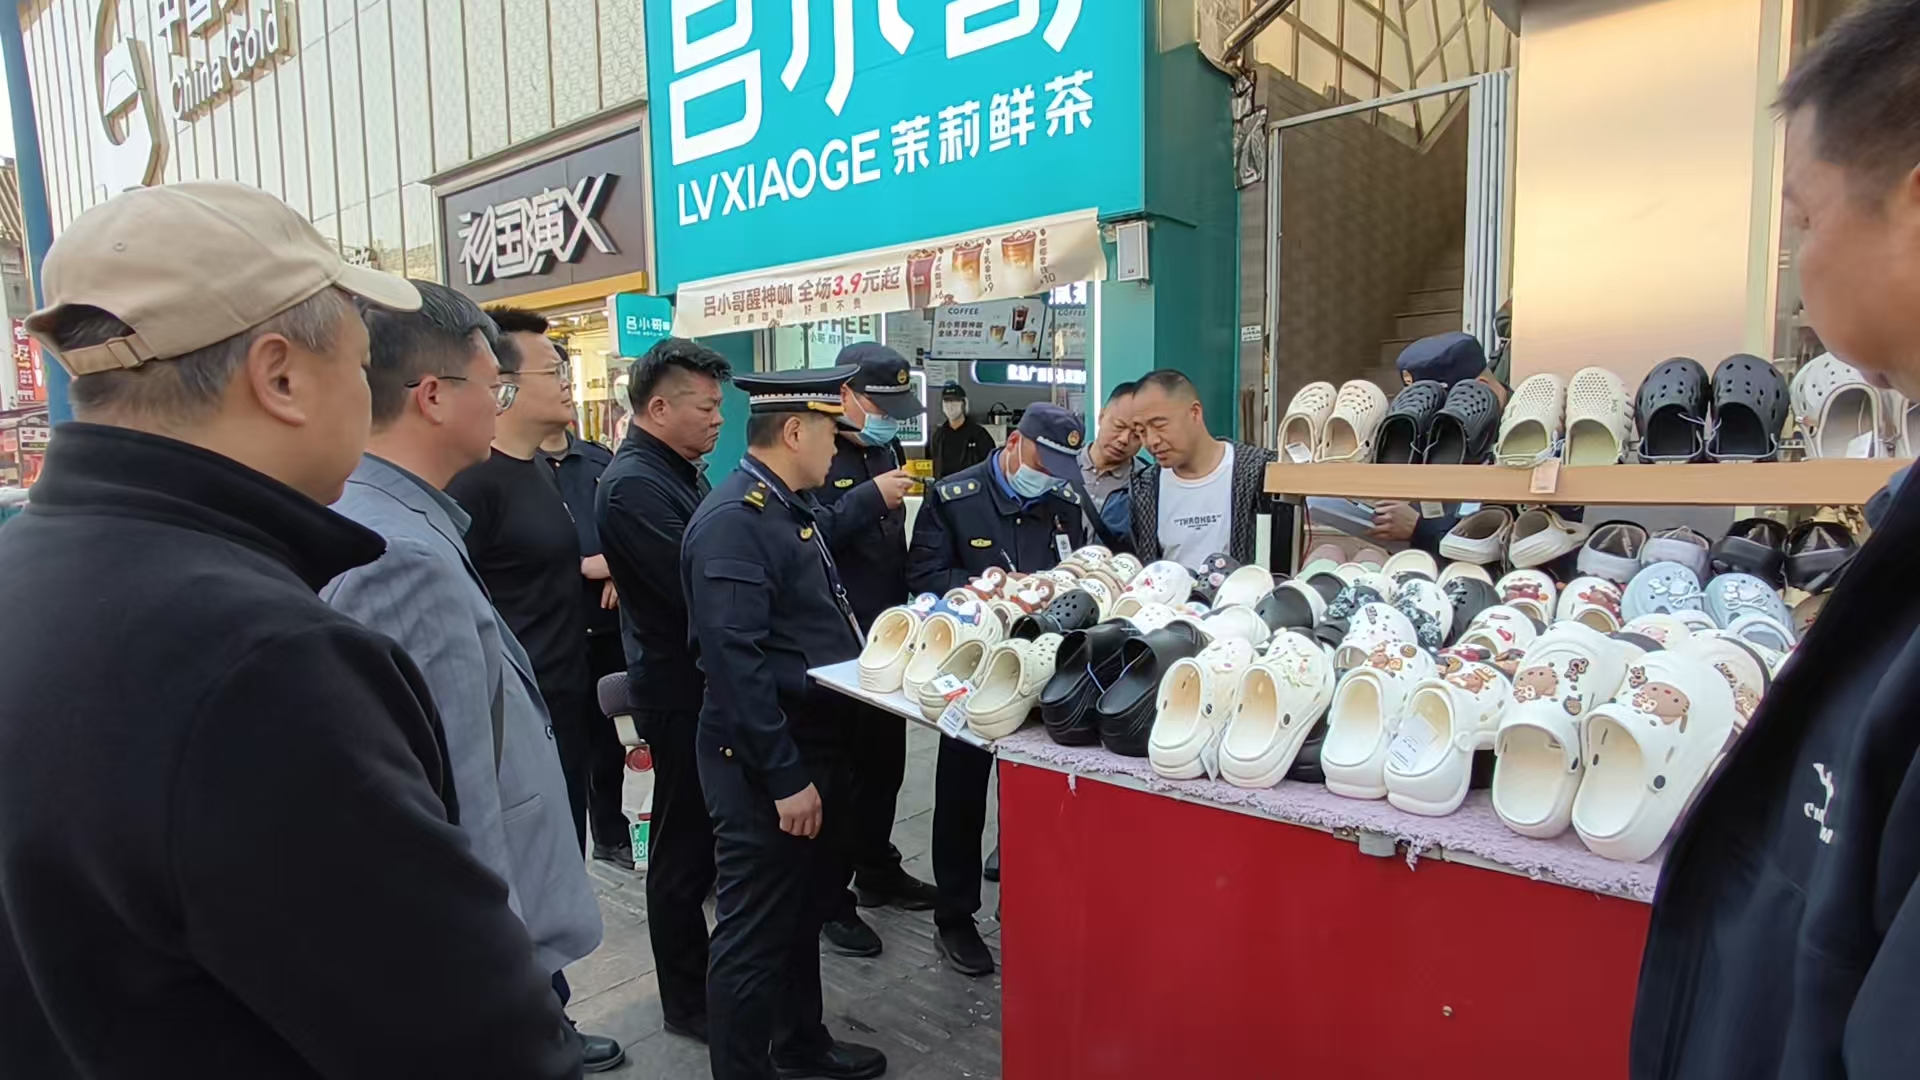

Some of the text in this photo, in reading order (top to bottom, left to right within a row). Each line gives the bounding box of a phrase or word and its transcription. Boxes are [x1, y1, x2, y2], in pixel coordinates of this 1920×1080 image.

[171, 0, 279, 120] China Gold
[678, 70, 1094, 226] LVXIAOGE 茉莉鲜茶
[703, 265, 901, 318] 吕小哥醒神咖 全场3.9元起
[947, 307, 980, 315] COFFEE
